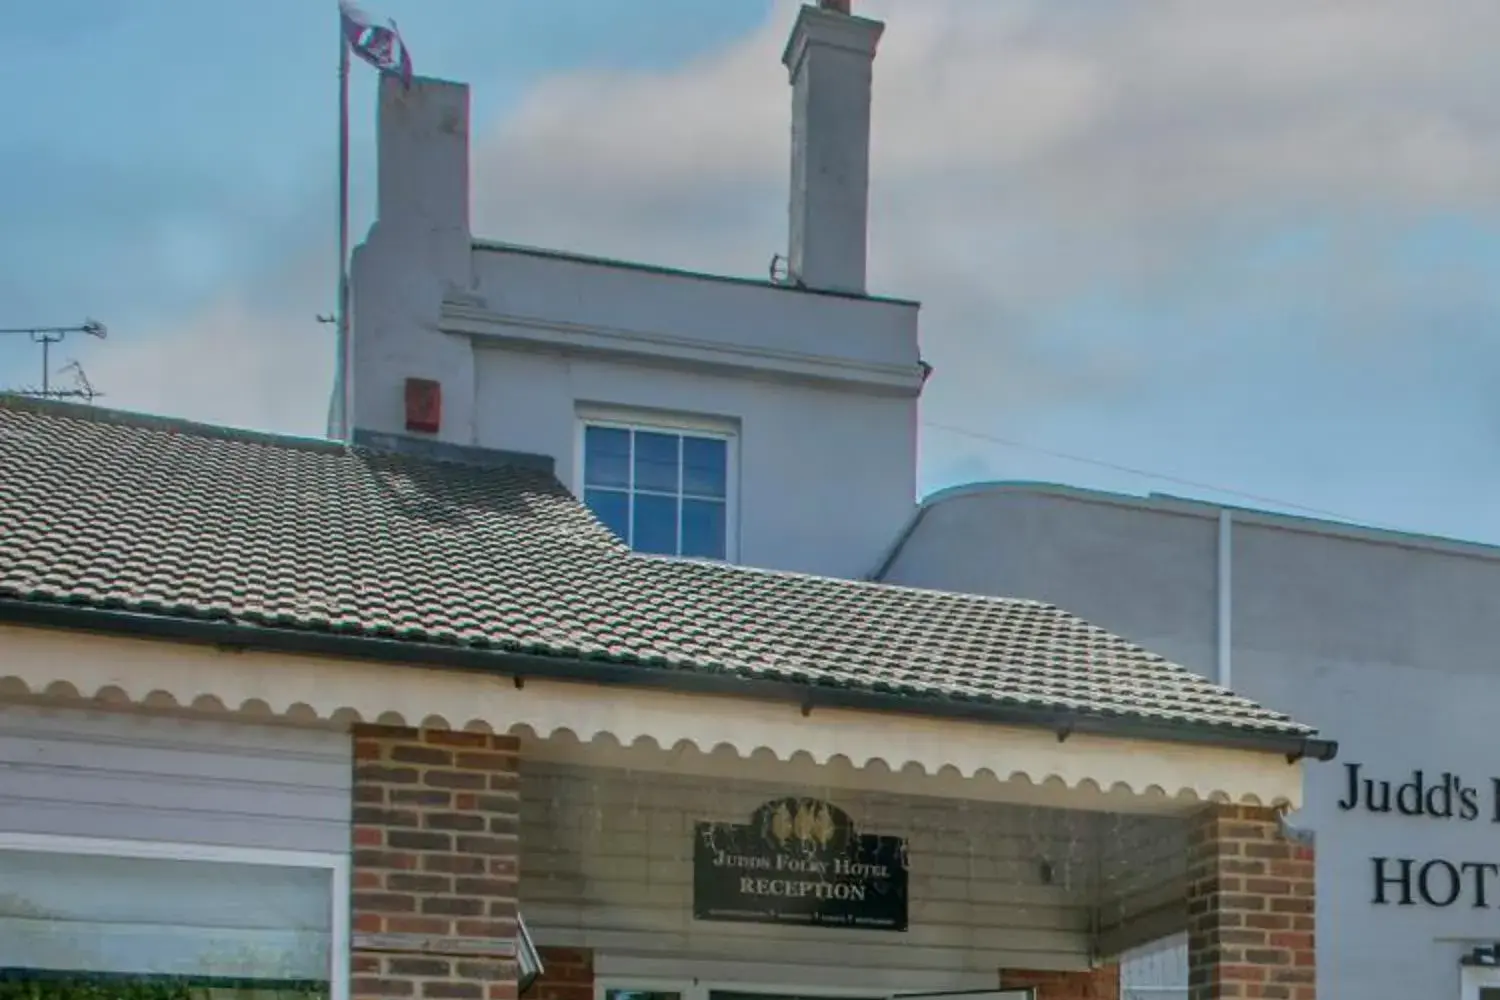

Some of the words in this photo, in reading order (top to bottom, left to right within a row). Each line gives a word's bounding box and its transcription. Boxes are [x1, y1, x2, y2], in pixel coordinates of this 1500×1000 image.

[1338, 762, 1479, 821] Judd's
[834, 858, 891, 879] HOTEL
[740, 876, 866, 901] RECEPTION
